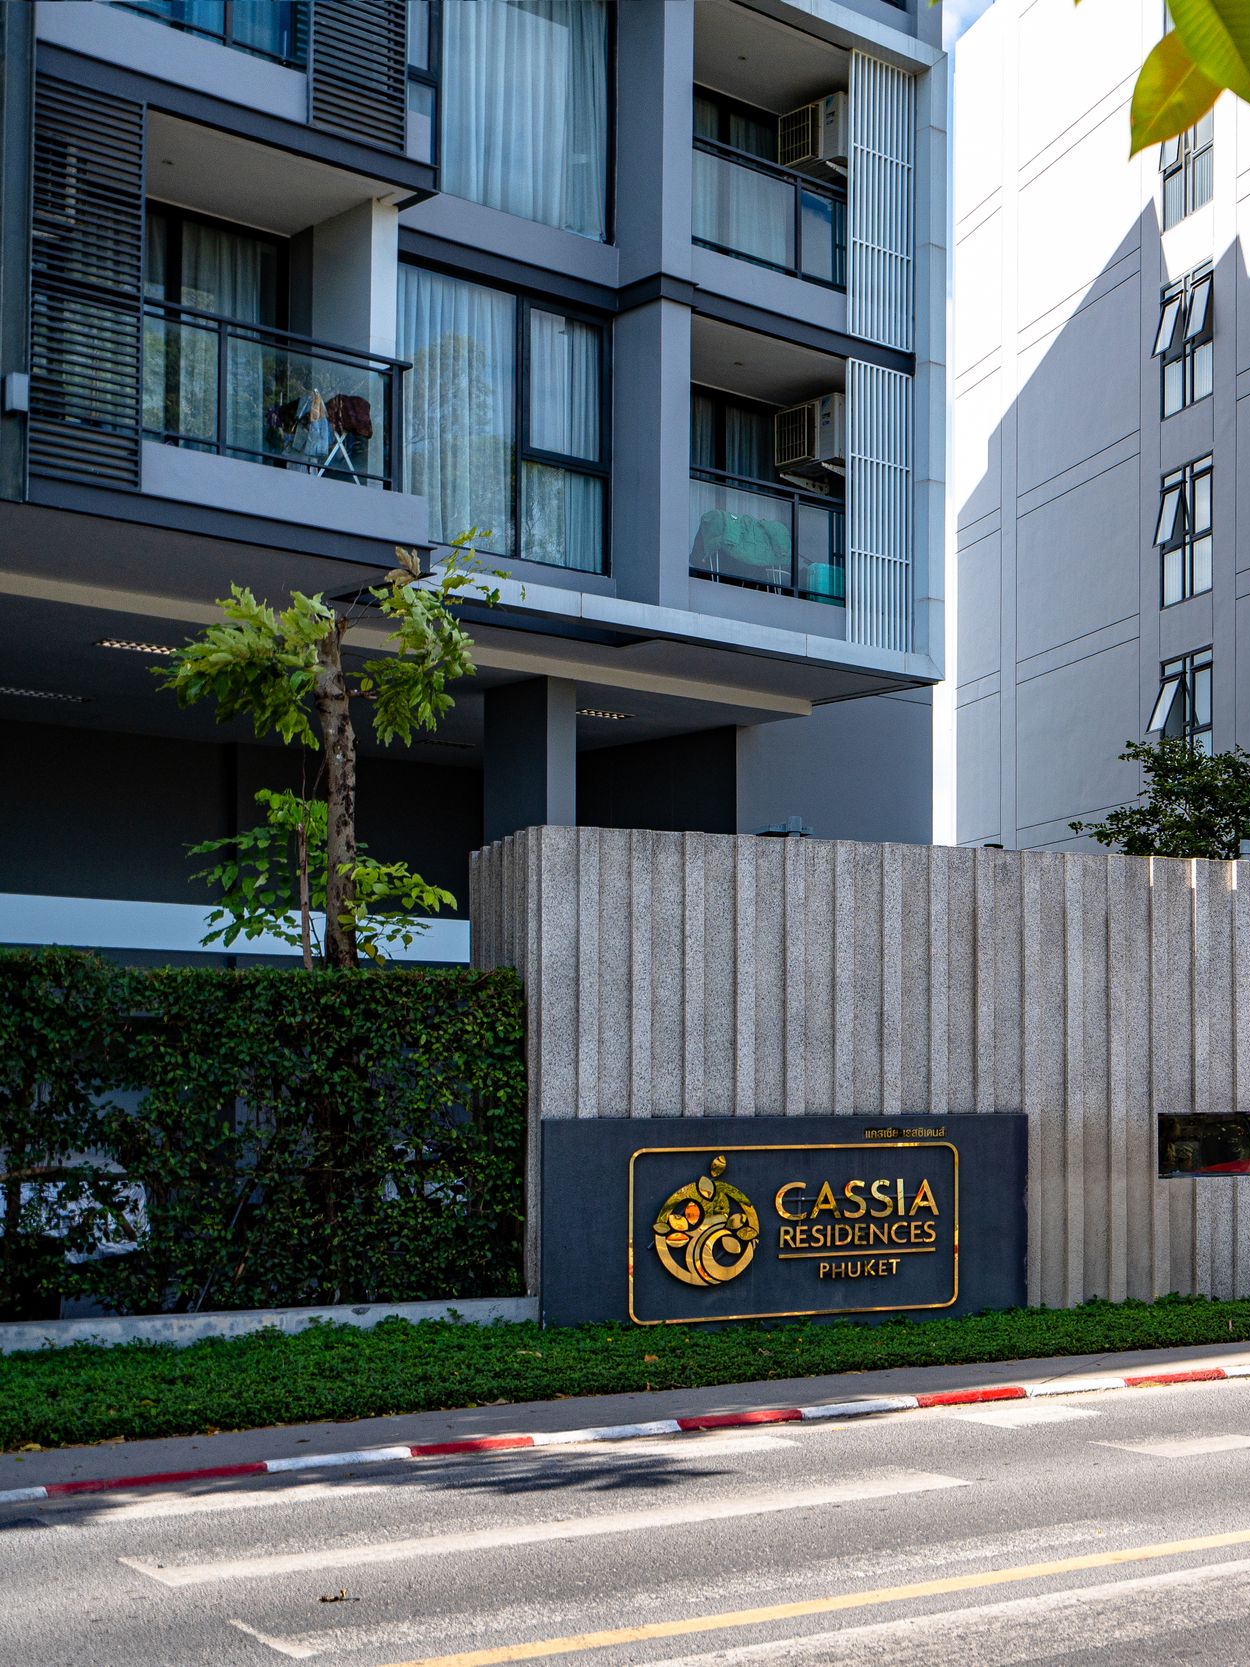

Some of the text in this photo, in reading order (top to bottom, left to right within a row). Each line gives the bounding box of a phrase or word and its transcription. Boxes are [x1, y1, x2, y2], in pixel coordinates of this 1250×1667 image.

[775, 1178, 940, 1221] CASSIA
[779, 1221, 937, 1249] RESIDENCES
[819, 1258, 901, 1279] PHUKET
